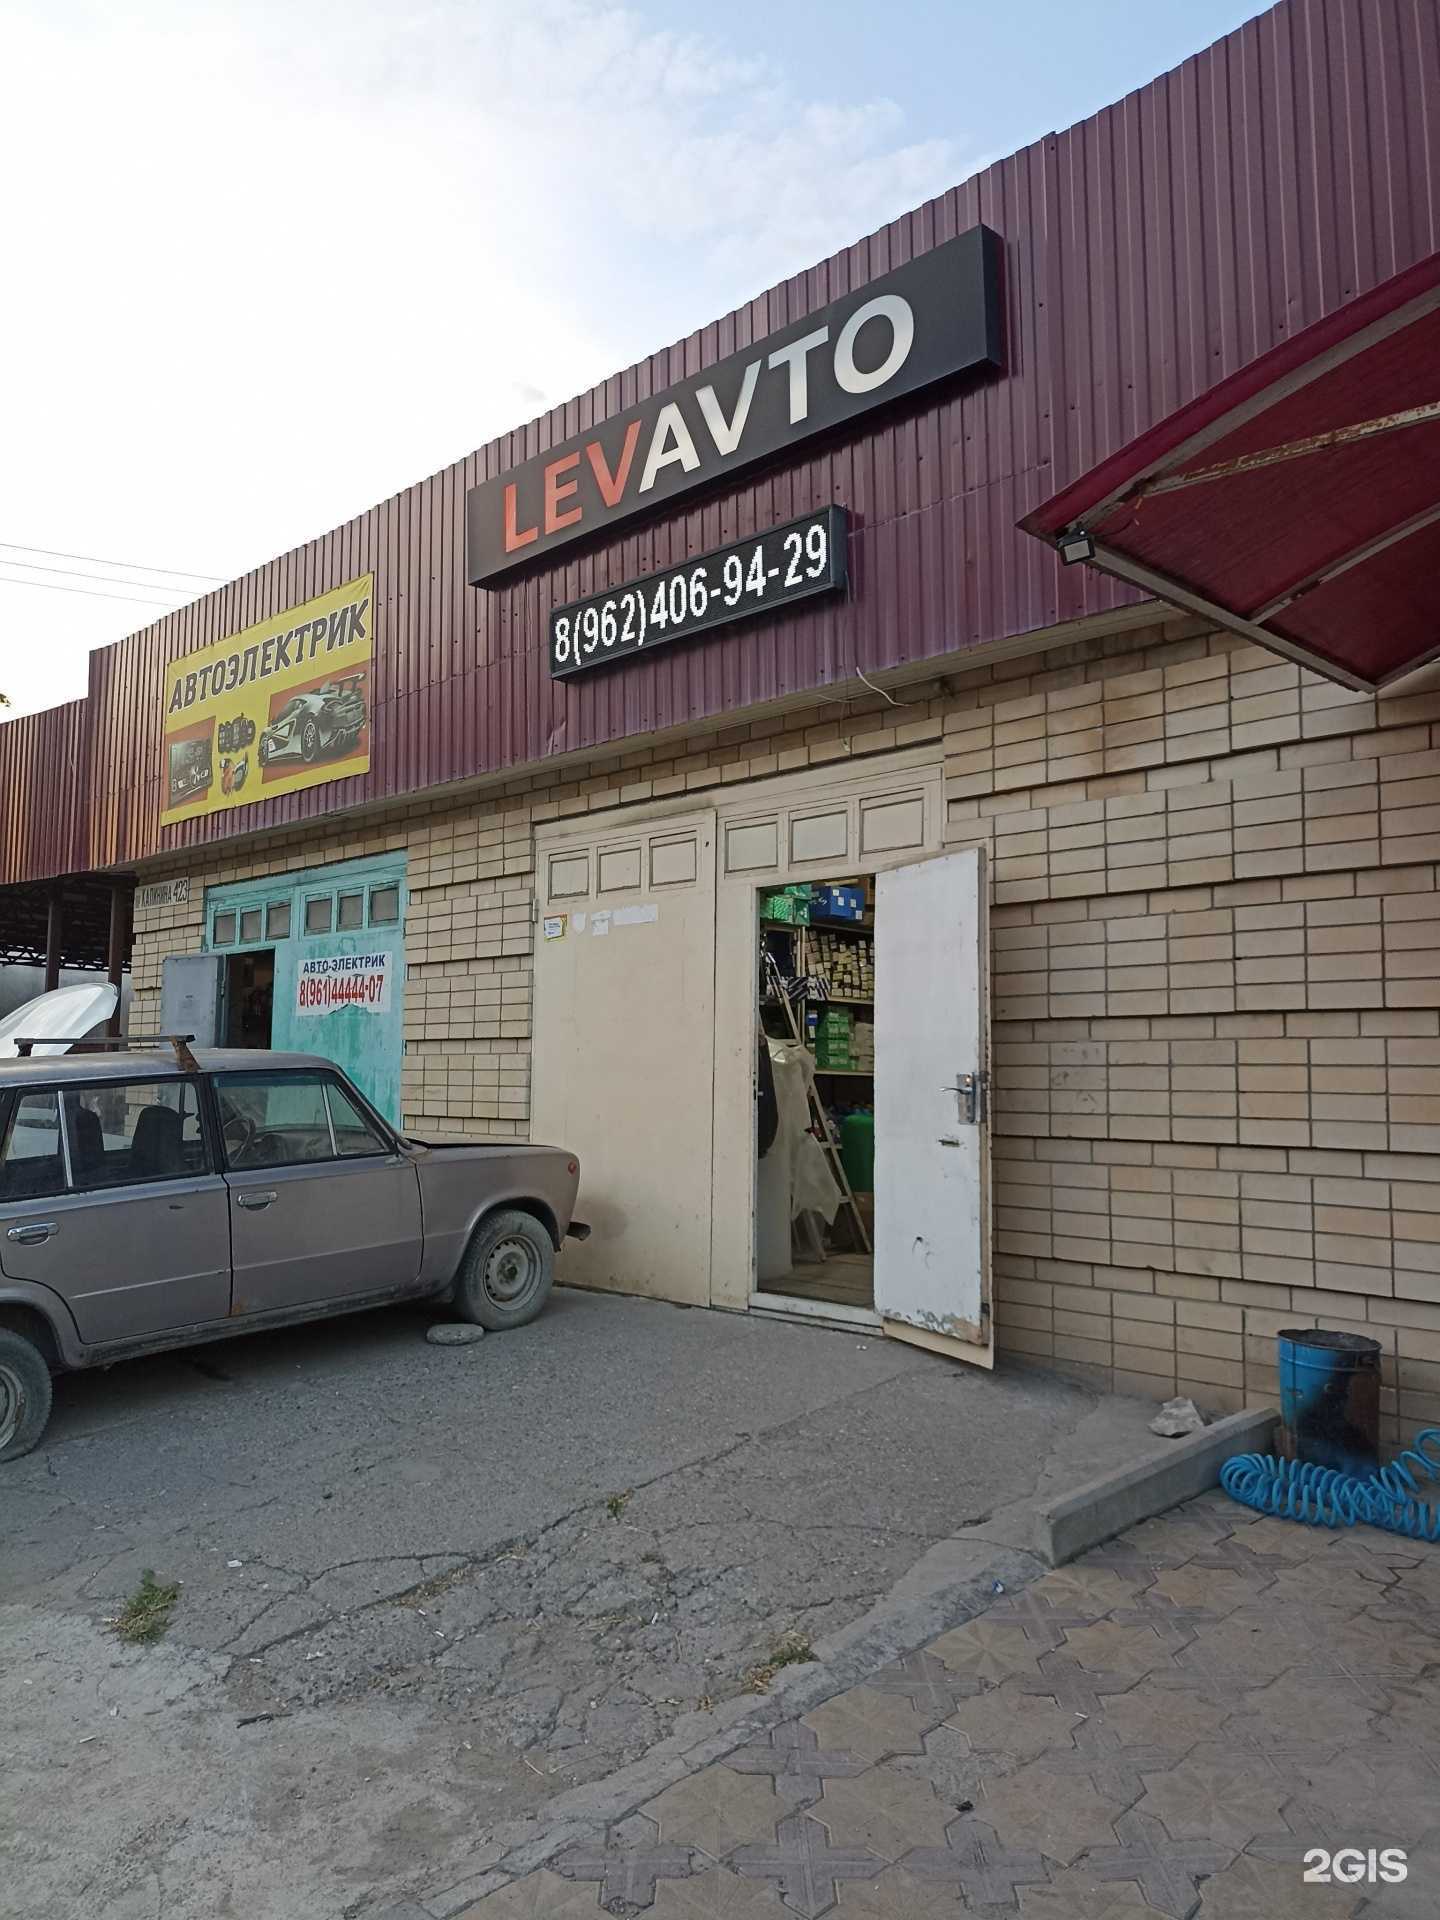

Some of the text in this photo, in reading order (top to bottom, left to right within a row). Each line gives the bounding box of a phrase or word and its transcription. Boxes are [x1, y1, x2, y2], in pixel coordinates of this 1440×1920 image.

[503, 294, 915, 553] LEVAVTO
[168, 598, 369, 714] АВТОЭЛЕКТРИК
[555, 524, 828, 666] 8(962)406-94-29
[303, 954, 386, 974] АВТО-ЭЛЕКТРИК
